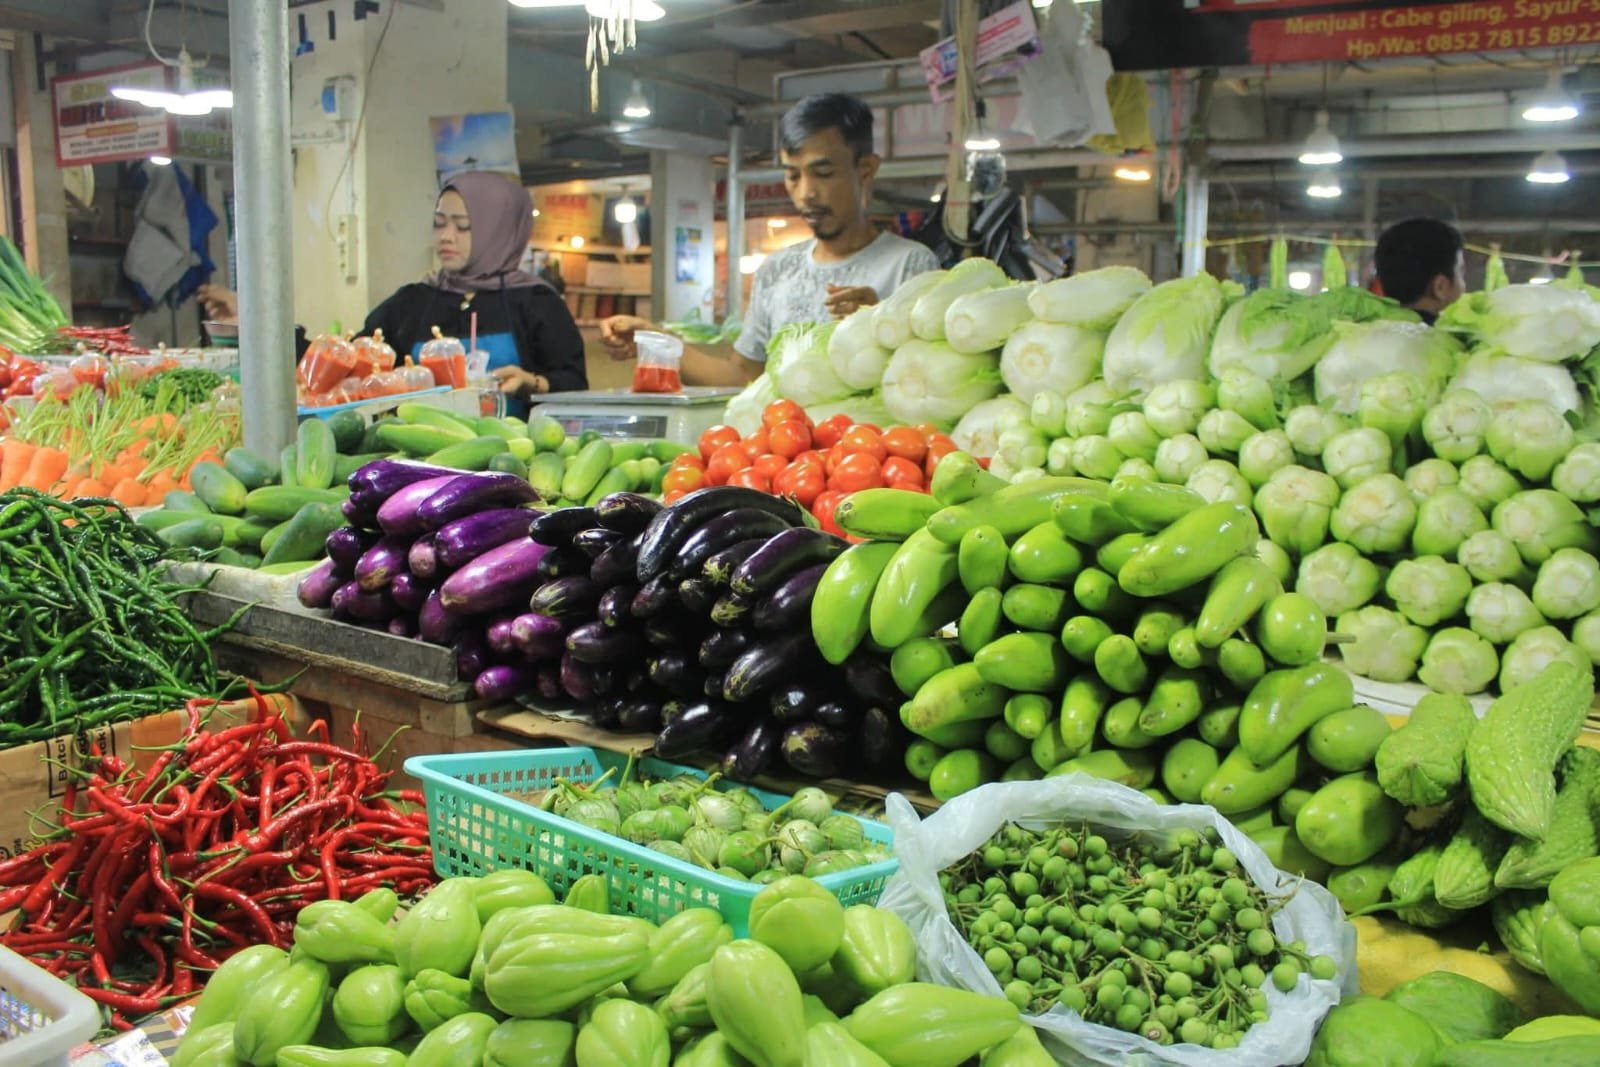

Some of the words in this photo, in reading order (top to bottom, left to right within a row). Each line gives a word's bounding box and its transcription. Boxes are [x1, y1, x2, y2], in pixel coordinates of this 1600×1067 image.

[1285, 12, 1366, 36] Menjual
[1381, 8, 1433, 28] Cabe
[1439, 4, 1507, 28] giling,
[1346, 36, 1422, 58] Hp/Wa:
[1427, 31, 1480, 52] 0852
[1487, 27, 1541, 48] 7815
